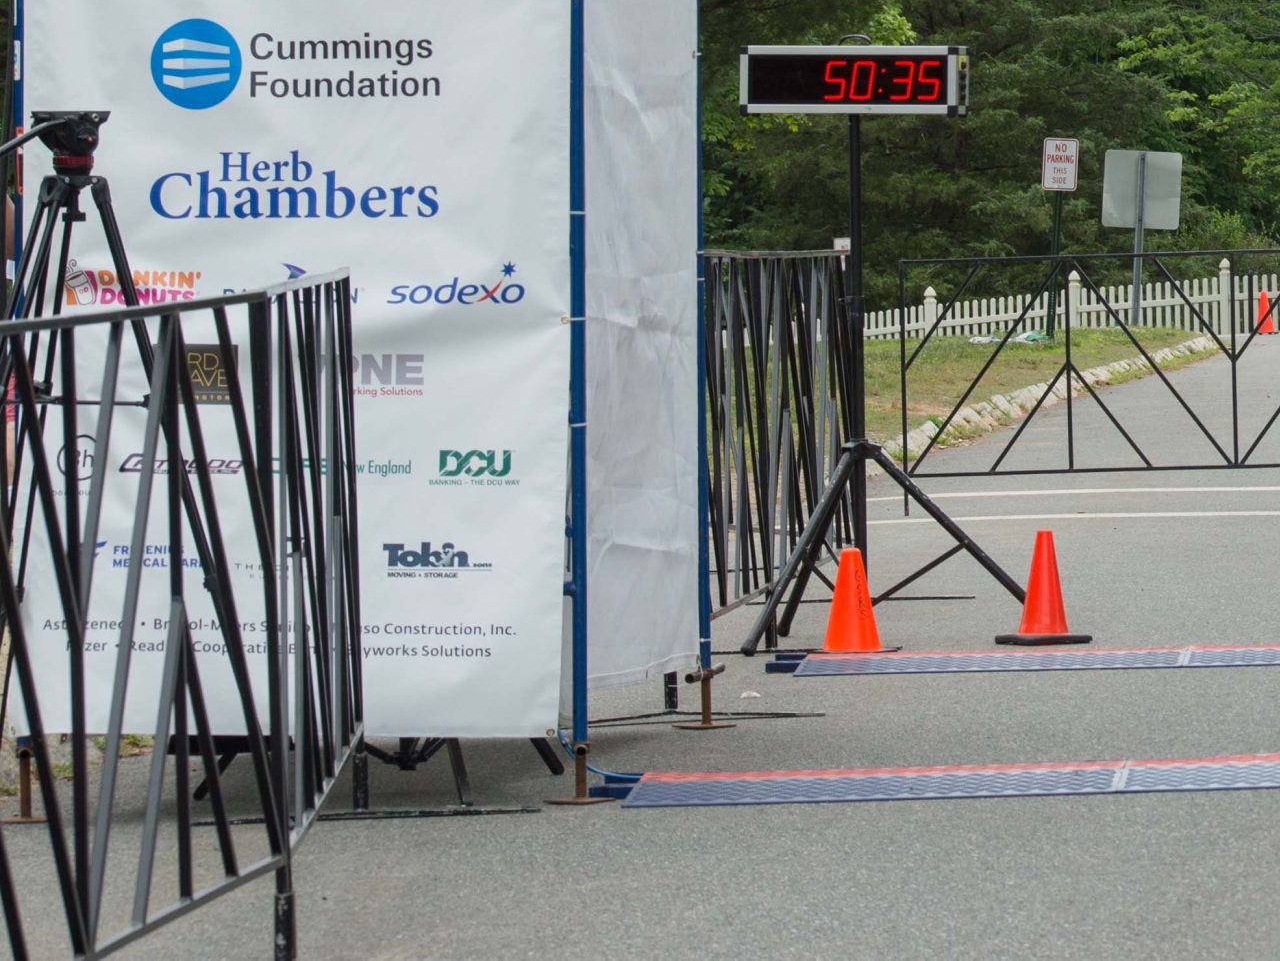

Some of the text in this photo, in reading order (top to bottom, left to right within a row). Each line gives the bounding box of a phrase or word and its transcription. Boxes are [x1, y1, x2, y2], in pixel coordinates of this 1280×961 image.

[250, 33, 433, 65] Cummings
[250, 72, 441, 98] Foundation
[824, 60, 941, 100] 50:35
[1055, 143, 1067, 152] NO
[219, 150, 313, 182] Herb
[1047, 154, 1074, 163] PARKING
[1053, 167, 1067, 175] THIS
[150, 170, 440, 219] Chambers
[98, 270, 201, 288] DNKIN'
[387, 276, 525, 304] sodexo
[352, 386, 423, 398] rking Solutions
[368, 460, 411, 477] England
[440, 450, 512, 476] DCU
[113, 558, 168, 567] MECAL
[384, 623, 486, 636] Construction,
[490, 624, 517, 636] Inc.
[421, 645, 492, 658] Solutions
